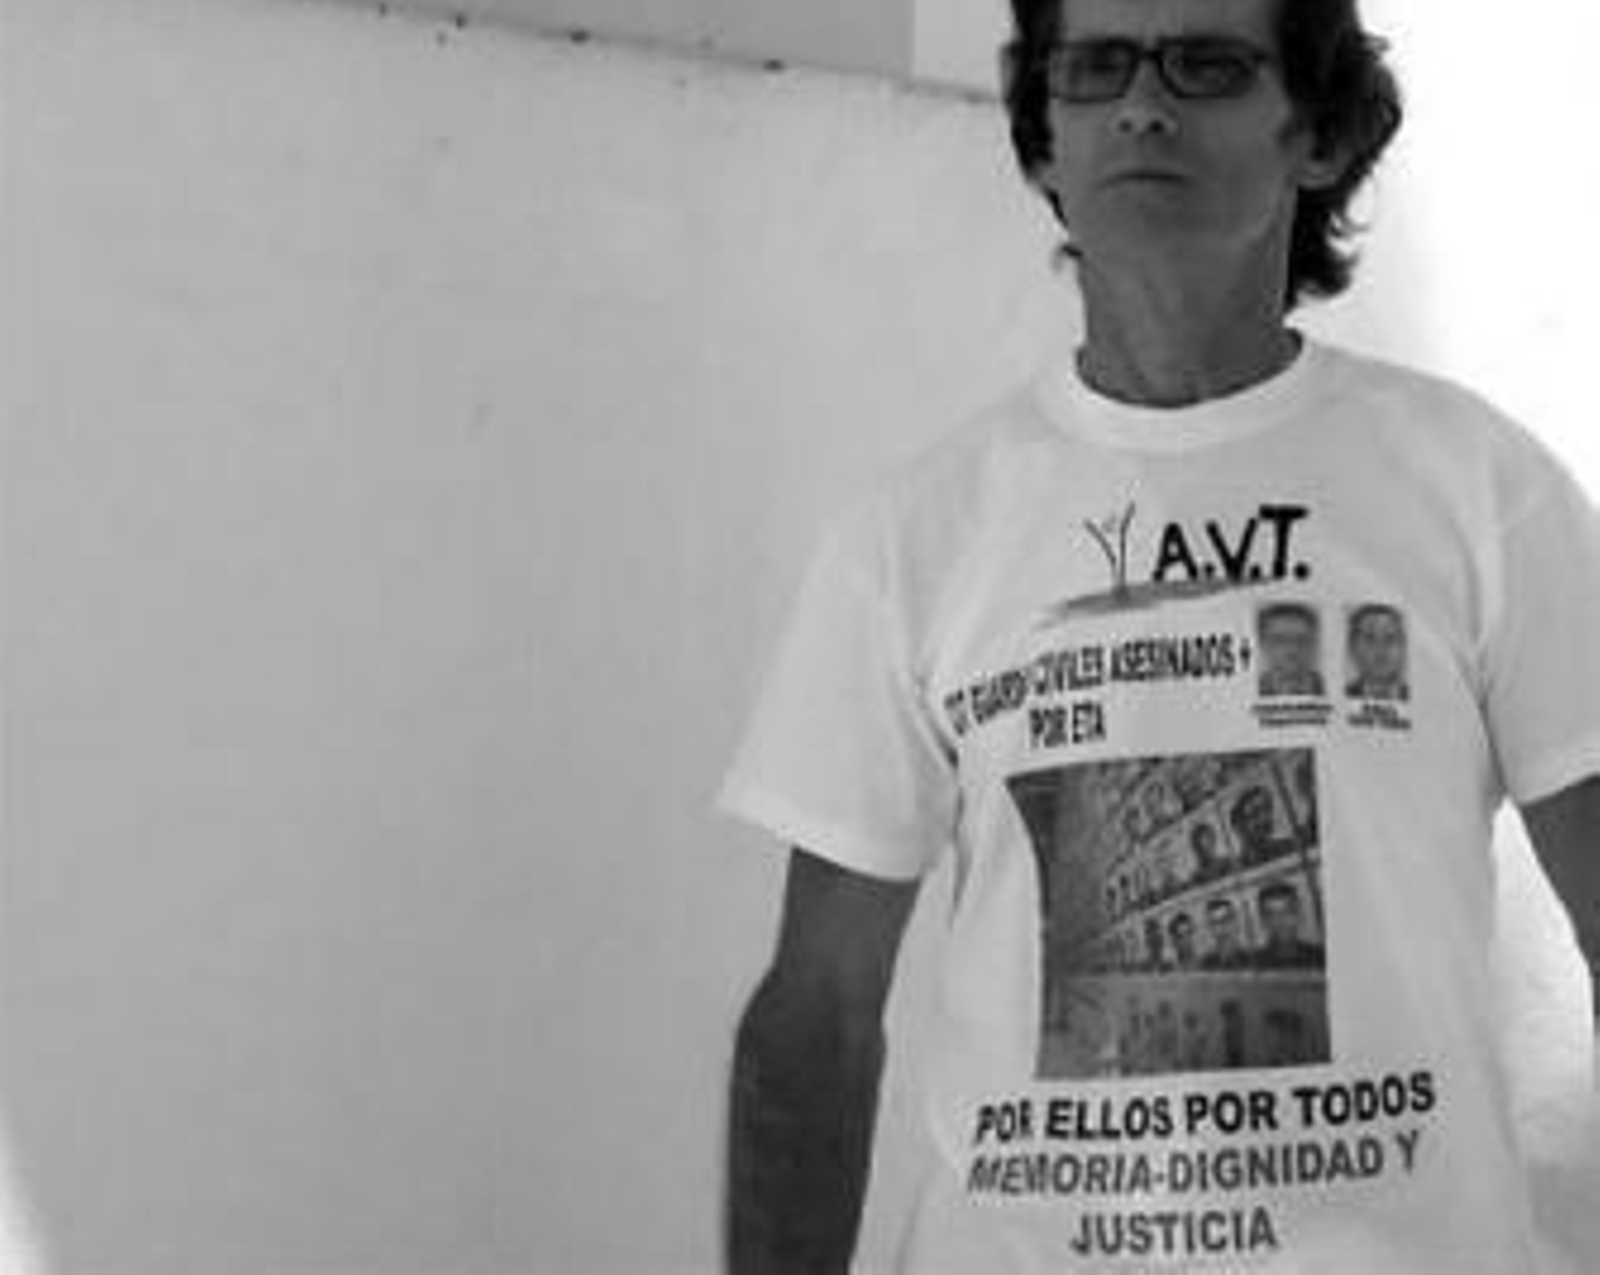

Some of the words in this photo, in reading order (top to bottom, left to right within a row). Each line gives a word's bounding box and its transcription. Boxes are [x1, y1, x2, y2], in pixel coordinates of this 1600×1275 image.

[1153, 504, 1310, 582] A.V.T.
[1072, 701, 1106, 745] ETA
[1046, 1096, 1173, 1140] ELLOS
[1184, 1089, 1278, 1134] POR
[1292, 1071, 1436, 1127] TODOS
[1396, 1127, 1418, 1172] Y
[1069, 1206, 1278, 1256] JUSTICIA
